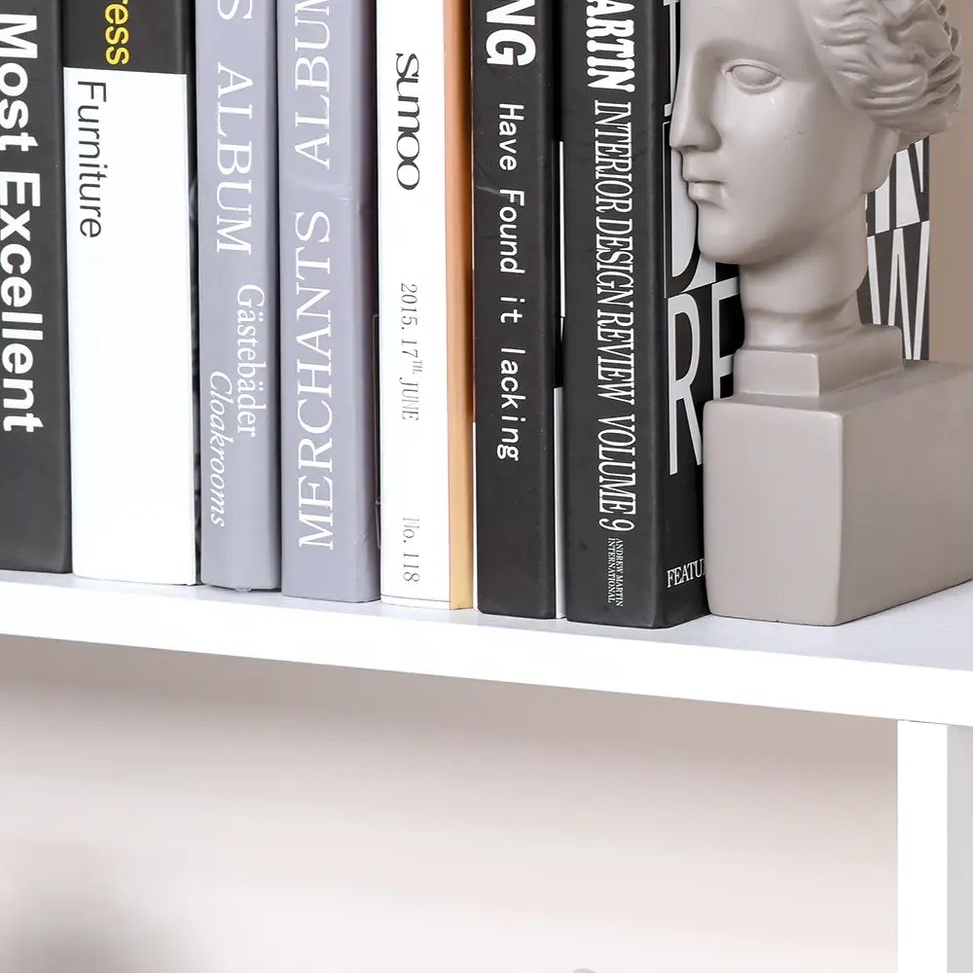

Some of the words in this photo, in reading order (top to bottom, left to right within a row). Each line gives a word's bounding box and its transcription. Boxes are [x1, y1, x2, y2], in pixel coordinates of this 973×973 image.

[0, 14, 38, 151] Most
[78, 81, 108, 238] Furniture
[217, 62, 253, 255] ALBUM
[500, 104, 524, 170] Have
[595, 100, 632, 212] INTERIOR
[500, 190, 525, 273] Found
[596, 216, 634, 308] DESIGN
[0, 172, 44, 432] Excellent
[401, 283, 417, 329] 2015.
[501, 297, 525, 323] it
[237, 285, 266, 437] Gästebäder
[295, 212, 333, 549] MERCHANTS
[399, 377, 418, 420] JUNE
[597, 309, 634, 405] REVIEW
[210, 372, 233, 526] Cloakrooms
[497, 348, 526, 461] lacking
[598, 414, 636, 514] VOLUME
[403, 553, 421, 583] 118
[599, 519, 634, 531] 9
[606, 536, 616, 605] INTERNATIONAL
[614, 536, 626, 575] ANDREW
[614, 575, 626, 607] MARTIN
[666, 558, 705, 588] FEATU
